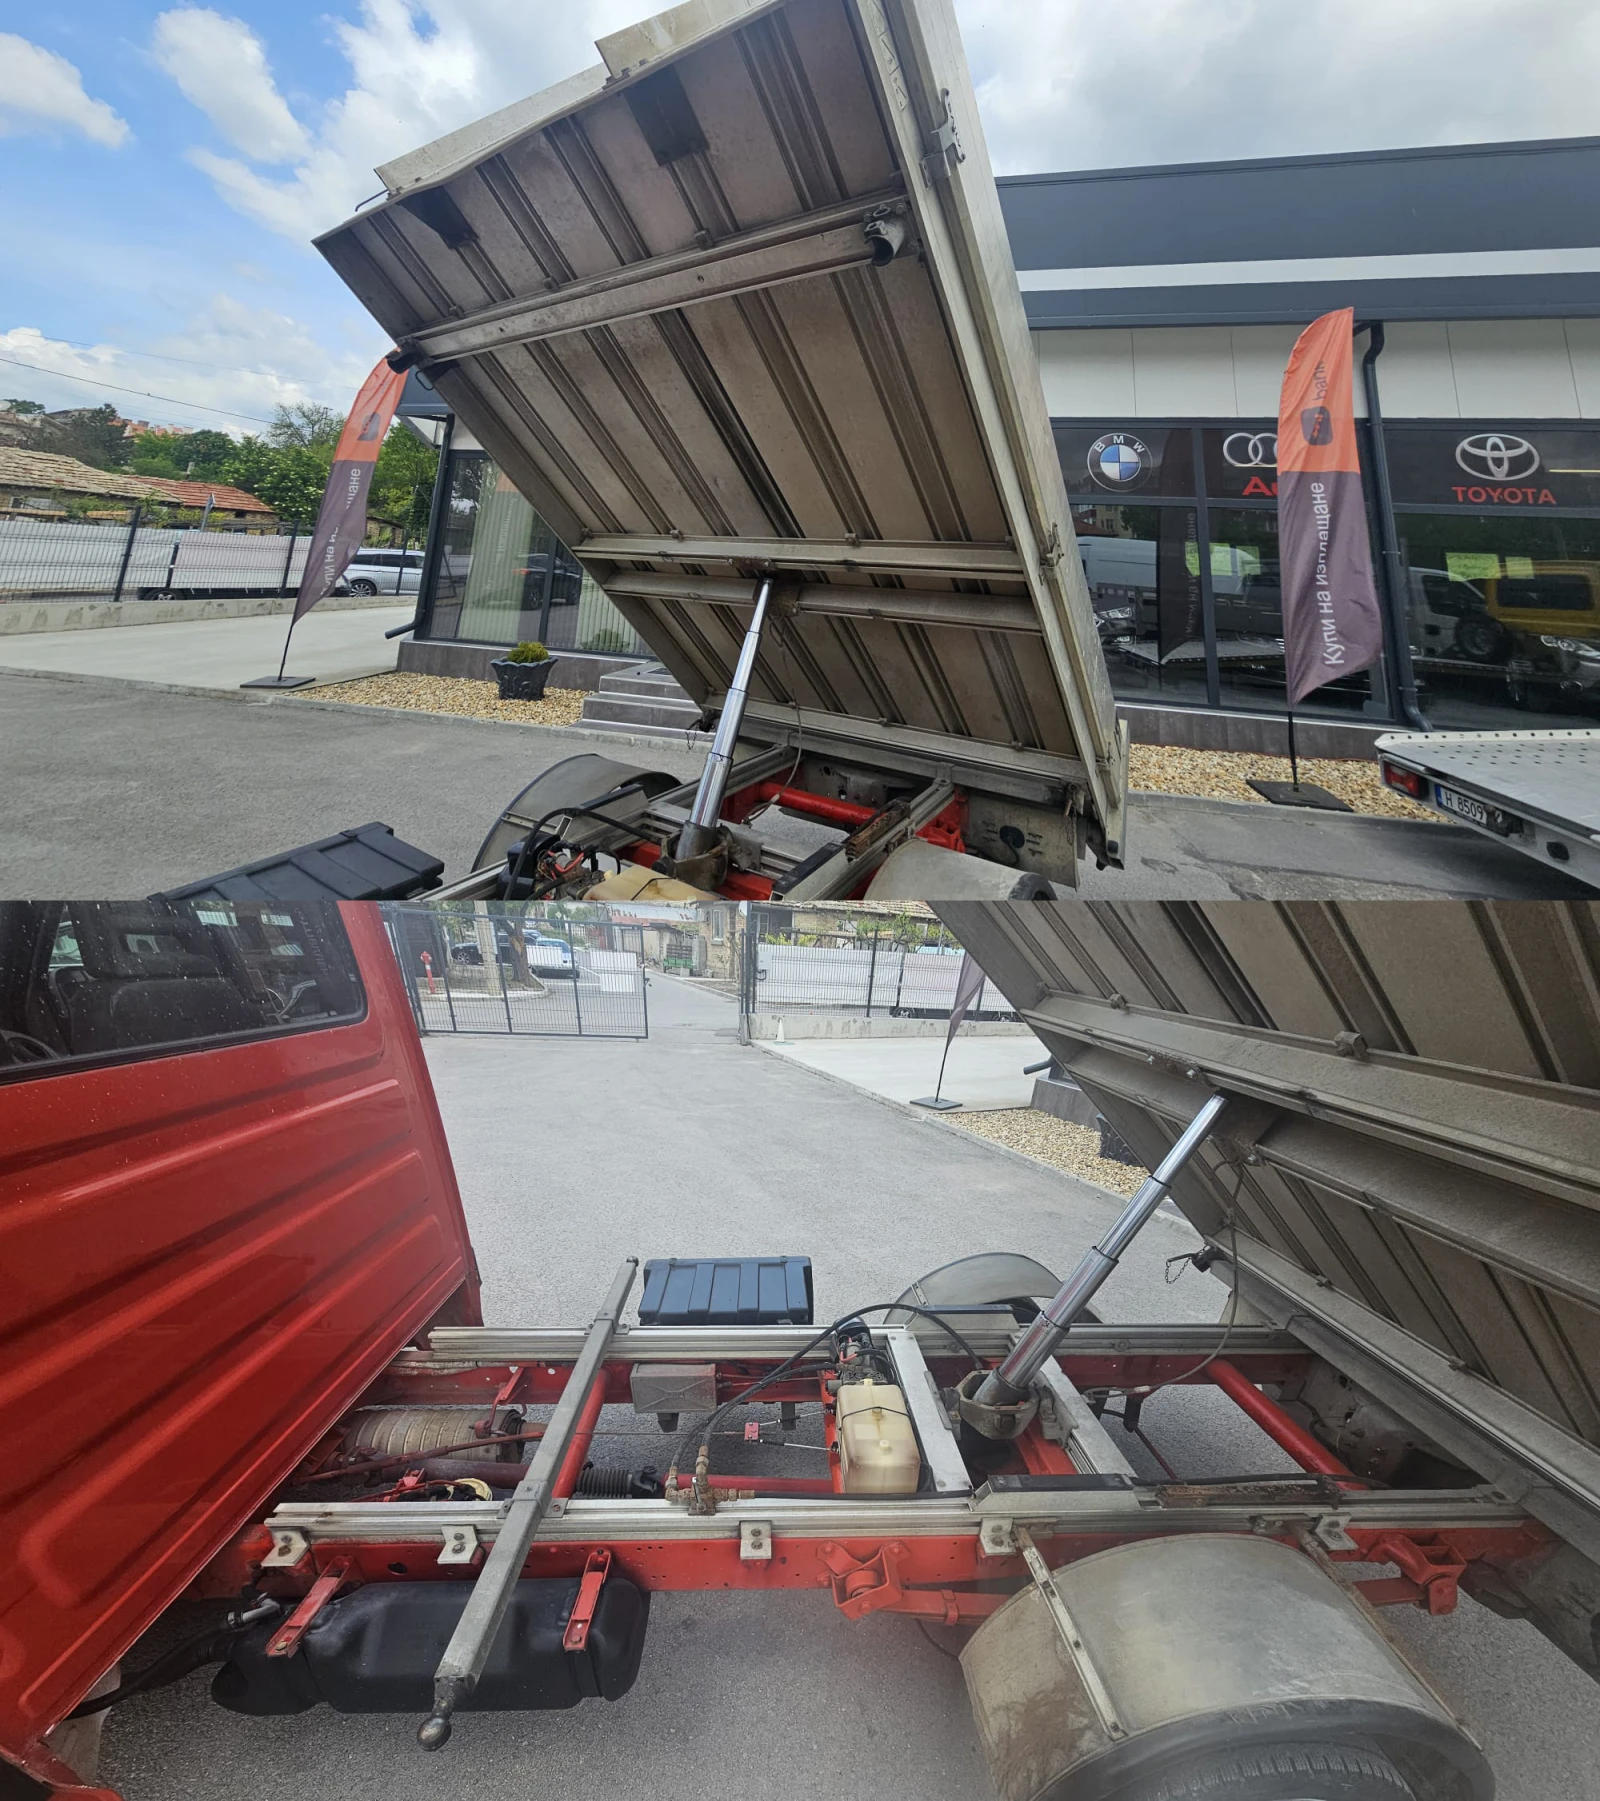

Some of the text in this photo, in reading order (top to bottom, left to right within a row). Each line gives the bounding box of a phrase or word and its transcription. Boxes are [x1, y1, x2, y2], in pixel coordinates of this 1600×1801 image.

[1094, 435, 1145, 453] BMW
[1451, 486, 1557, 505] TOYOTA
[1311, 481, 1345, 665] Купи на изплащане
[1445, 791, 1453, 807] H
[1457, 797, 1484, 821] 8509
